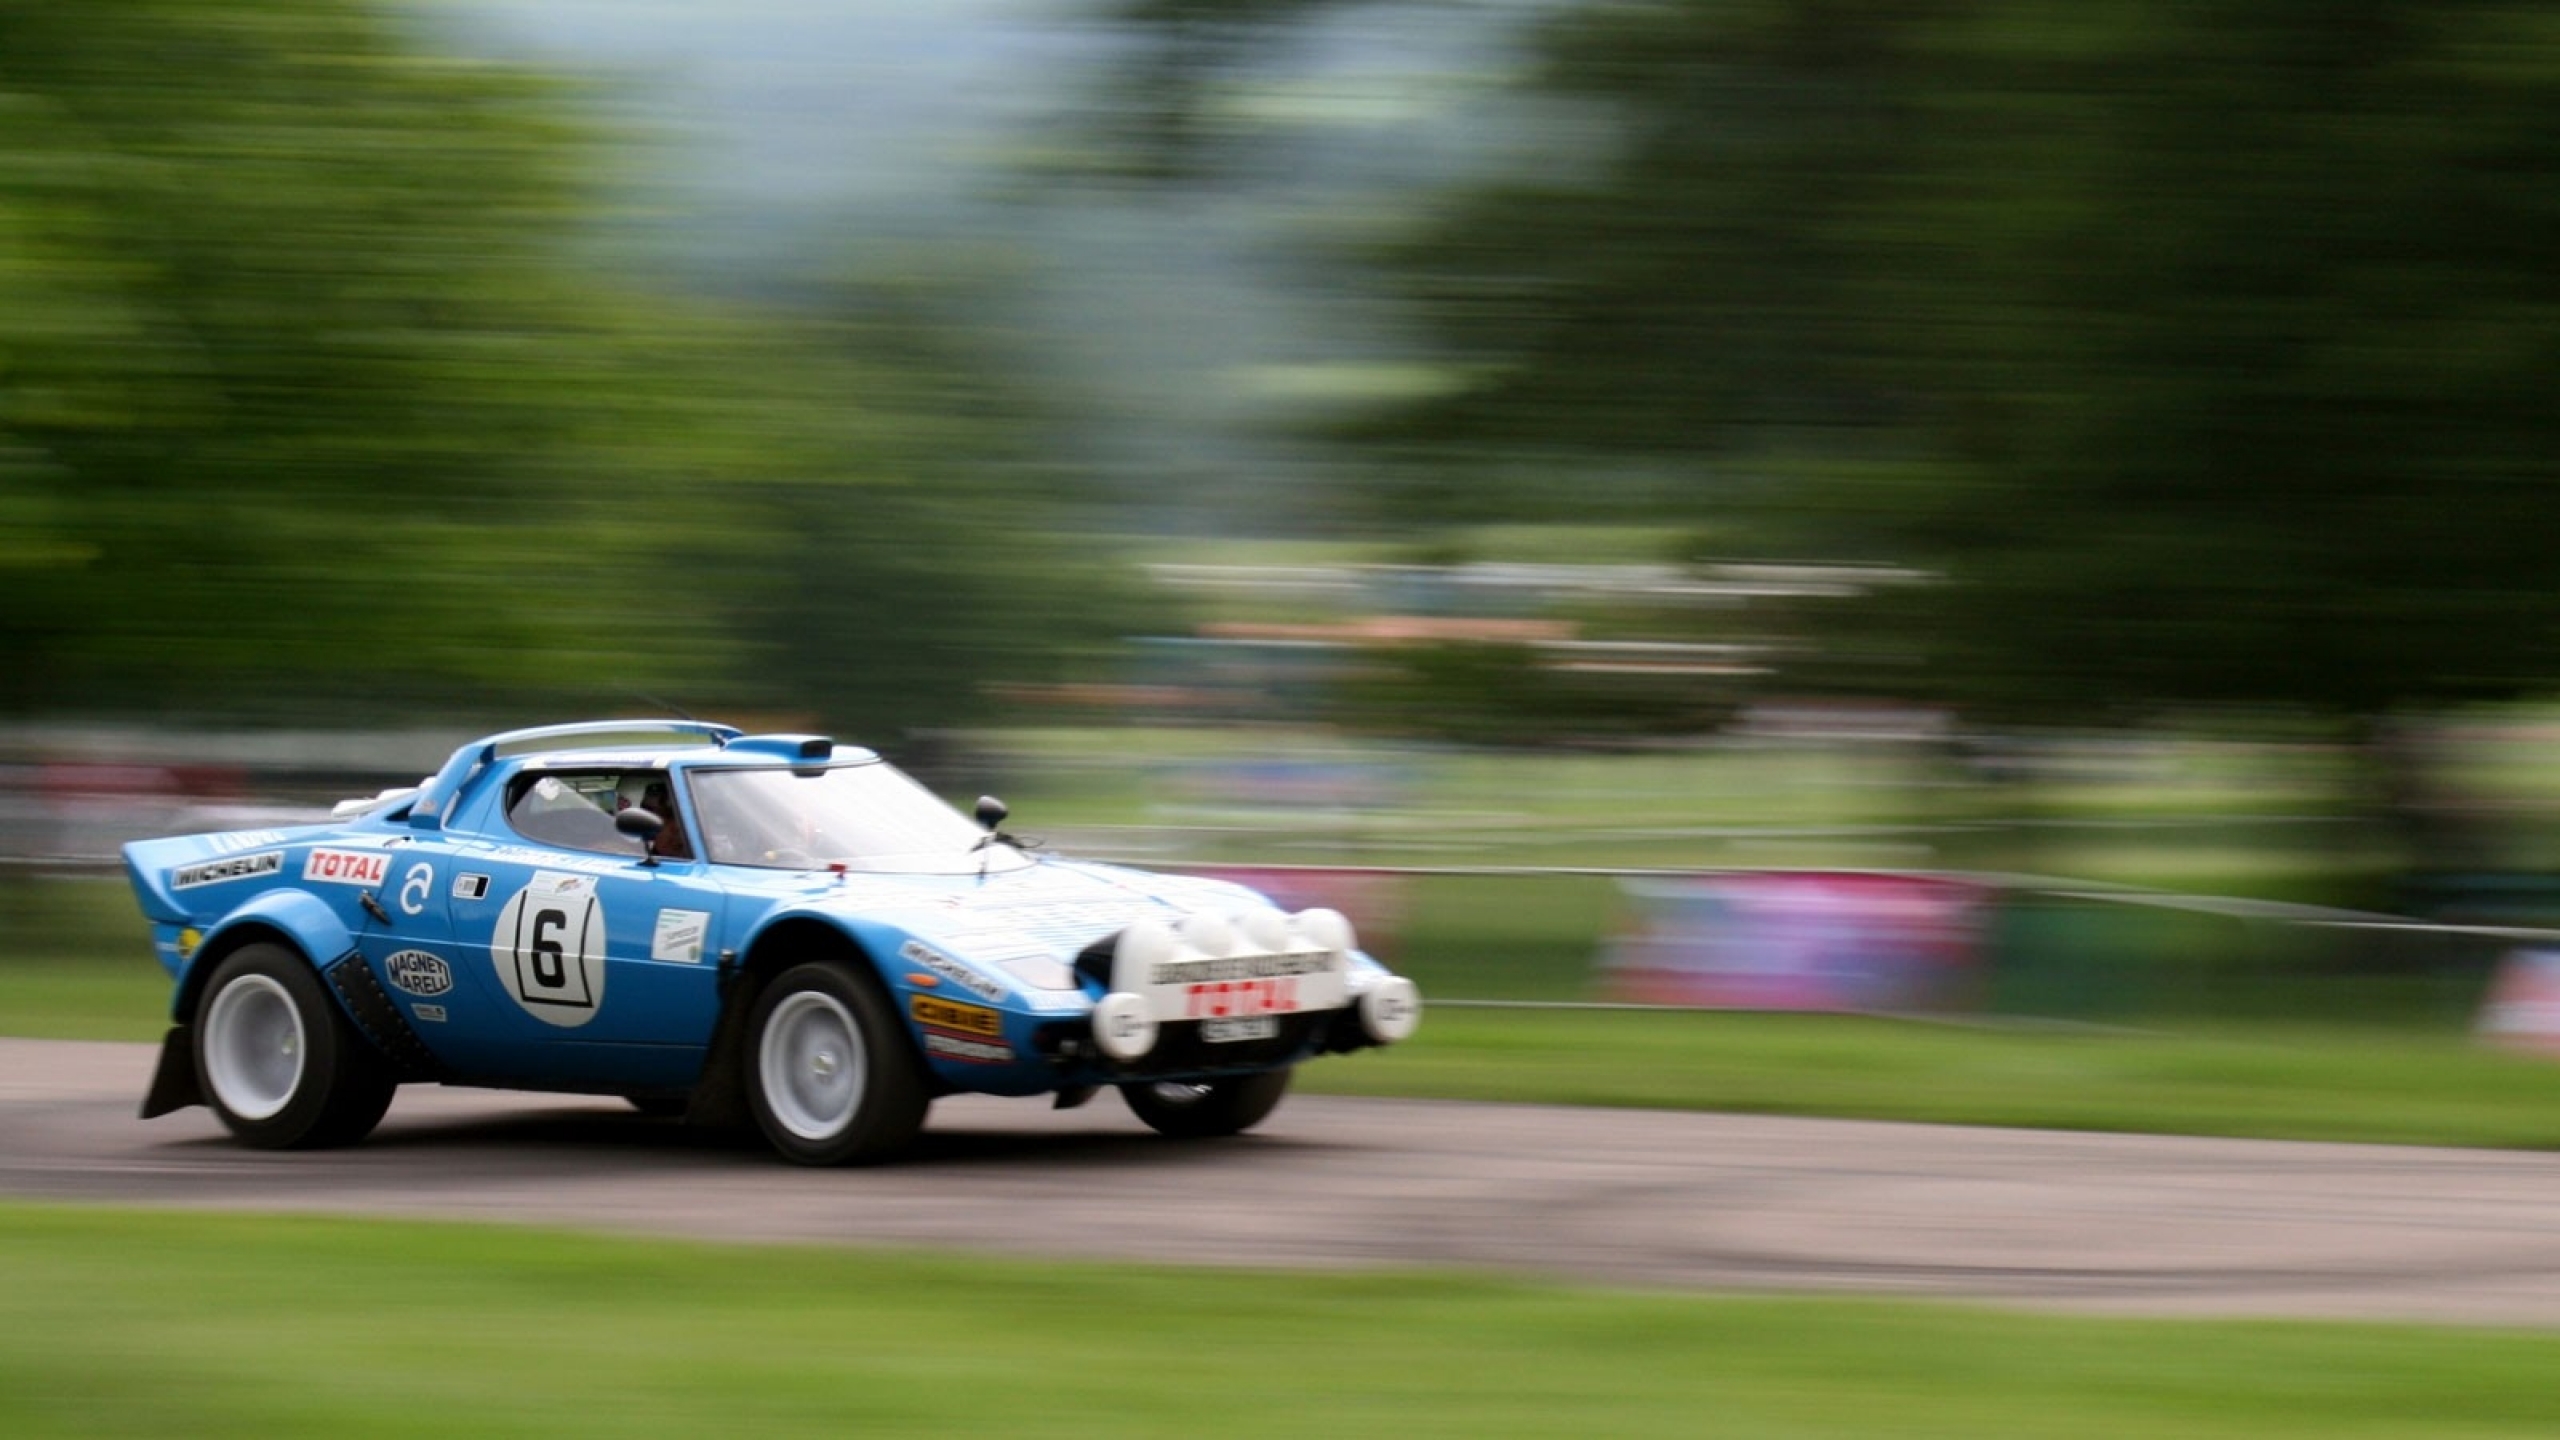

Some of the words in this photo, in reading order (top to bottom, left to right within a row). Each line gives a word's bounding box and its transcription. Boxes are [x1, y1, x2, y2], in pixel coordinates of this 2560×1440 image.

[174, 854, 280, 886] MICHELIN
[310, 852, 382, 881] TOTAL
[531, 908, 566, 988] 6
[1186, 978, 1299, 1017] TOTAL
